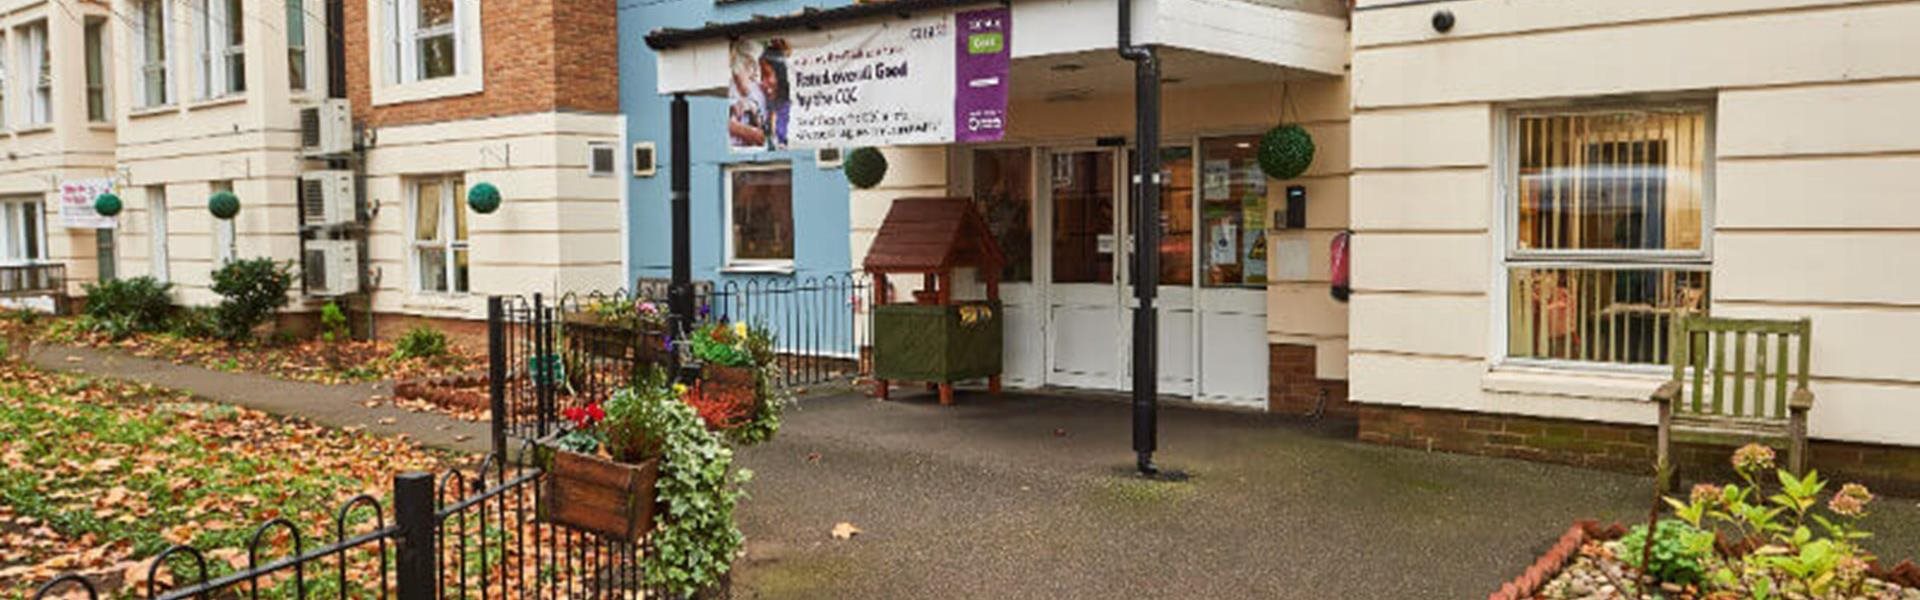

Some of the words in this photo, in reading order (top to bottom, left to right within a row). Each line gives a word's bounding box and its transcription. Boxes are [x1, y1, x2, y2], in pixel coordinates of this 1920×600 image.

[832, 64, 872, 84] overall
[875, 60, 907, 80] Good
[796, 91, 812, 111] by
[813, 90, 833, 106] the
[835, 86, 858, 105] CQC
